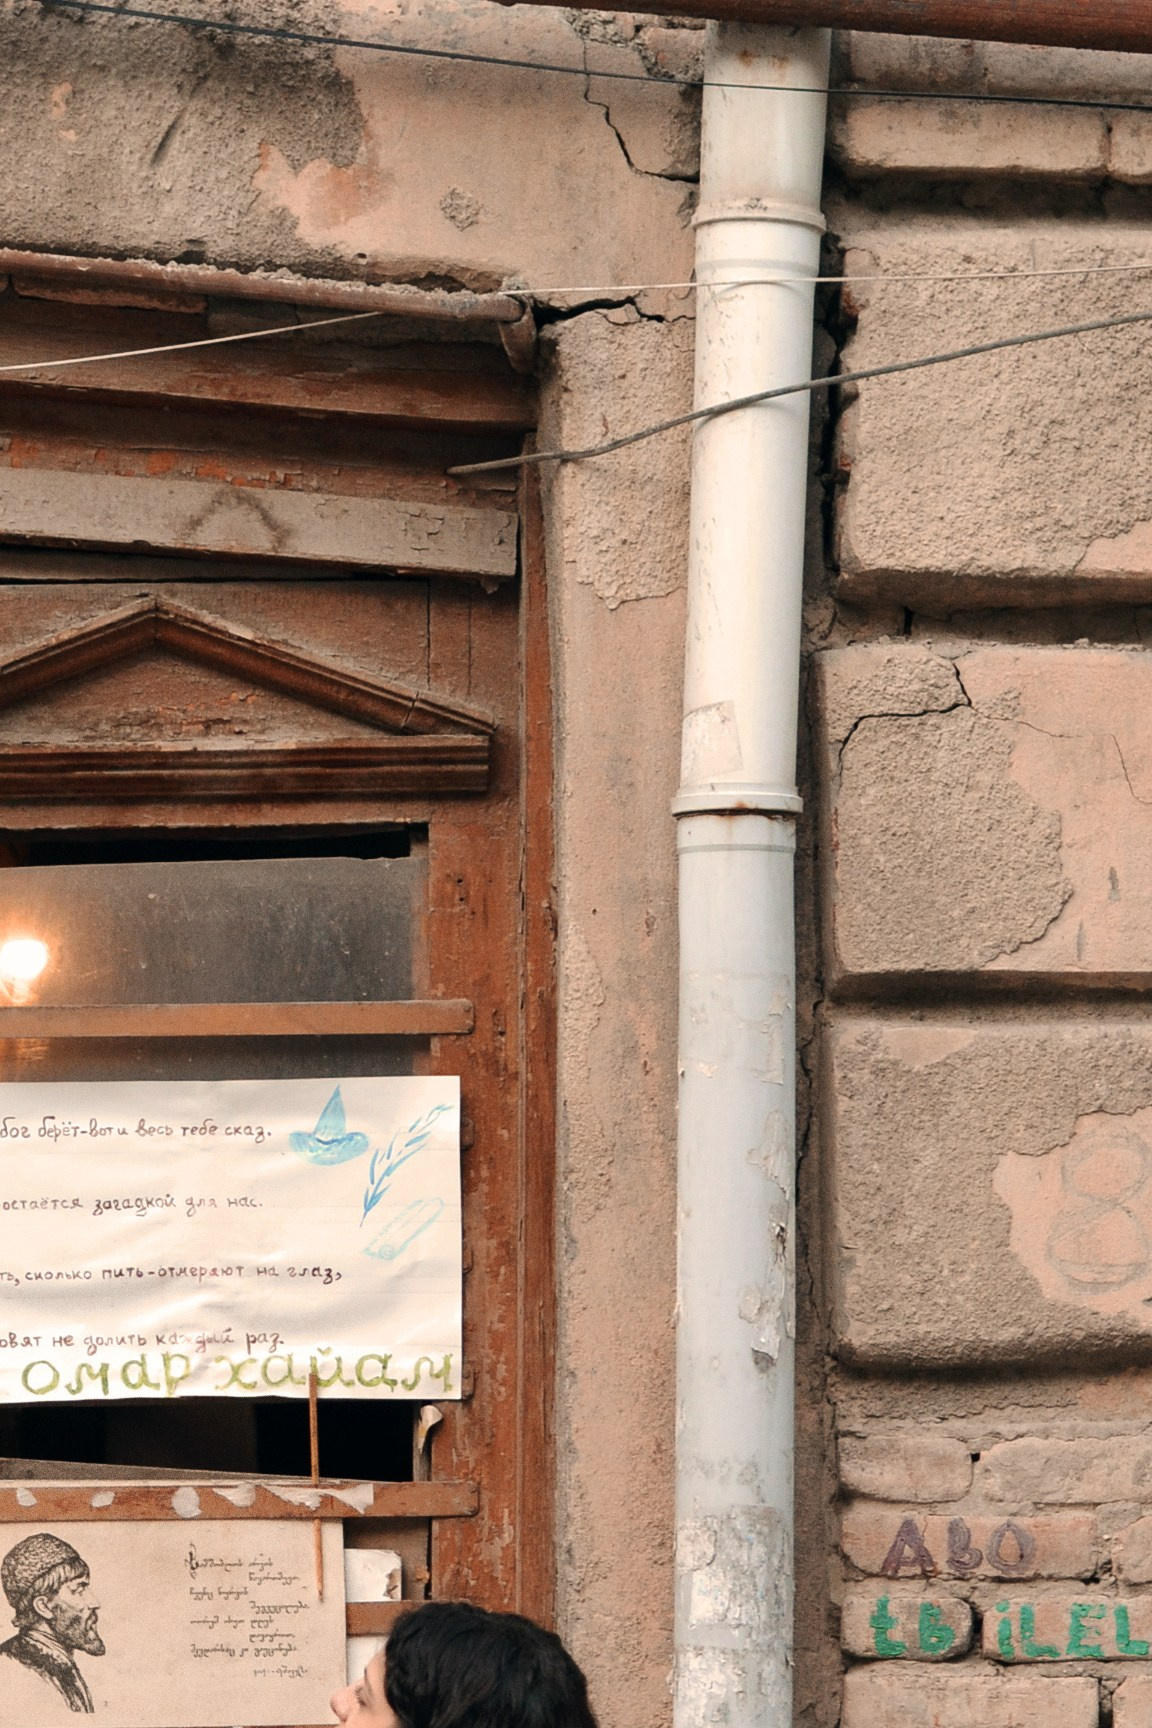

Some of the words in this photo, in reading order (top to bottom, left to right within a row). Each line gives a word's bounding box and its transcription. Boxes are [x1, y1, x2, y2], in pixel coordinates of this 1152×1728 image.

[134, 1118, 174, 1137] весь
[180, 1118, 219, 1137] тебе
[92, 1193, 177, 1217] загадкой
[184, 1196, 218, 1218] для
[24, 1269, 93, 1281] сколько
[256, 1266, 280, 1277] на
[52, 1334, 76, 1347] не
[83, 1334, 148, 1356] долить
[155, 1327, 236, 1354] каждый
